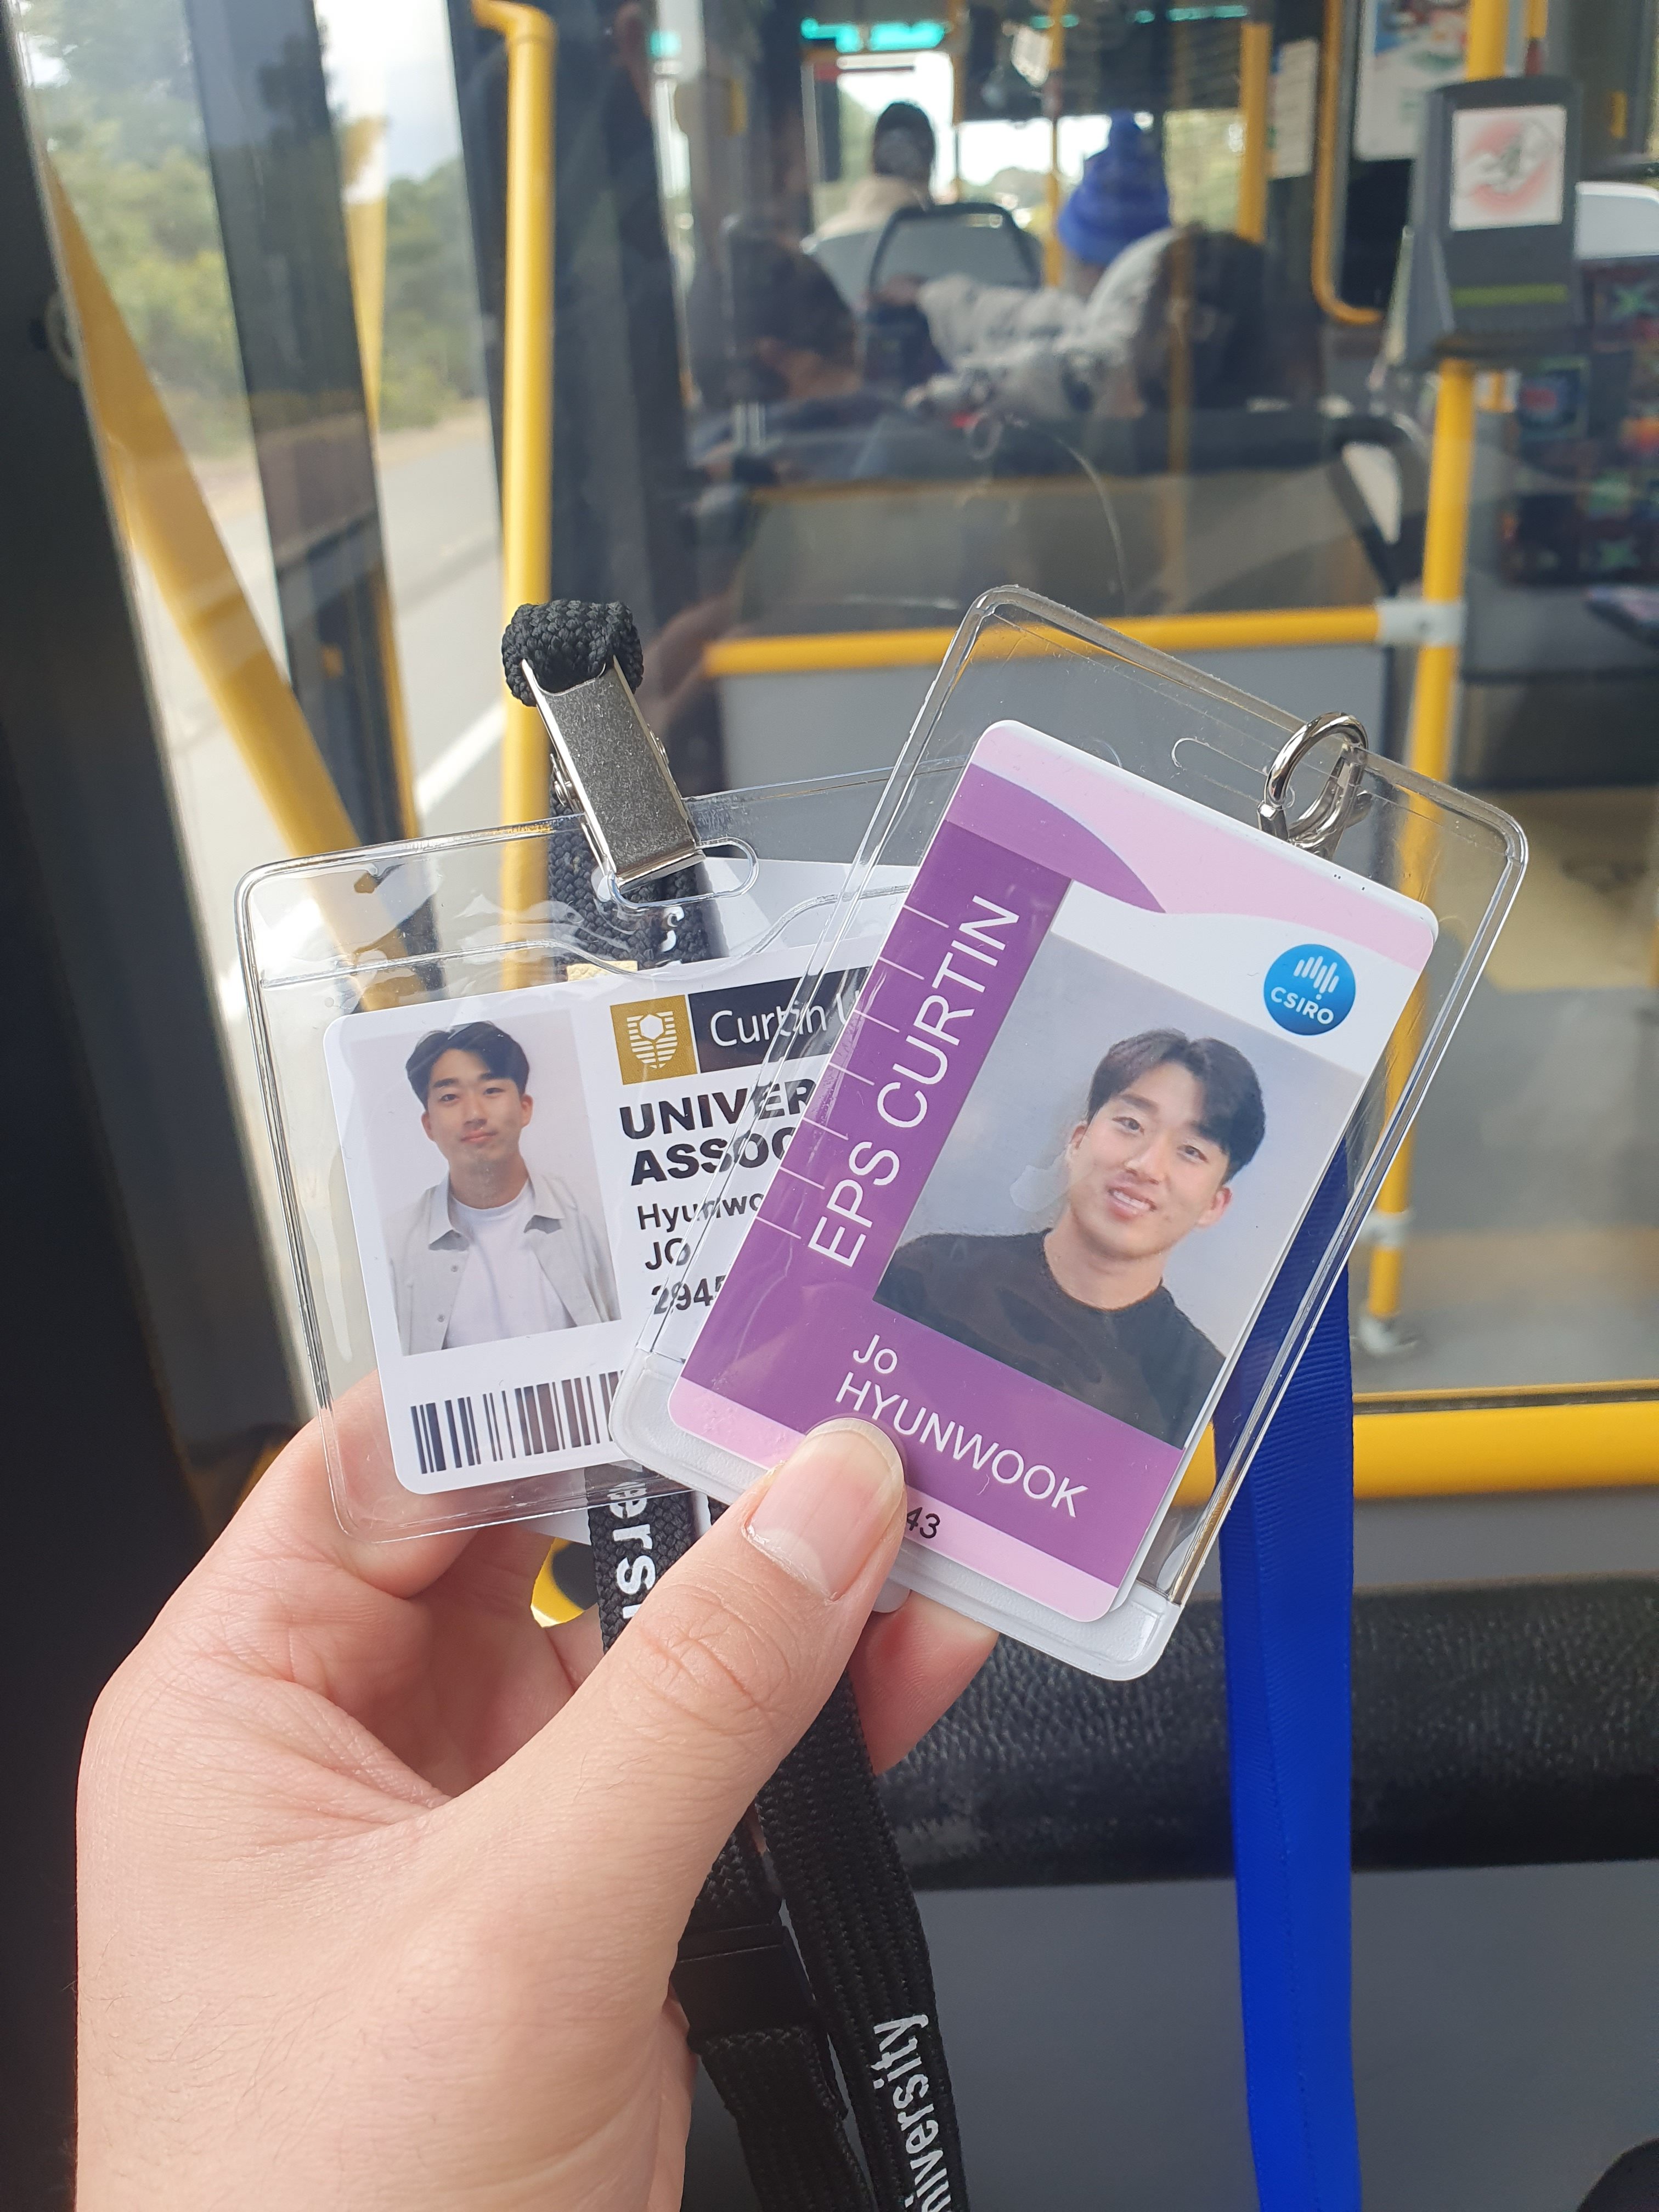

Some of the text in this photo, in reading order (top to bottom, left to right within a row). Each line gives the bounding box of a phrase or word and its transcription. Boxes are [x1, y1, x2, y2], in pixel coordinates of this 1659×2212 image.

[710, 1000, 827, 1047] Curtin
[1270, 986, 1334, 1025] CSIRO
[808, 895, 1020, 1268] EPS CURTIN
[619, 1078, 817, 1139] UNIVER
[645, 1237, 691, 1270] JO
[835, 1372, 1088, 1518] HYUNWOOK
[906, 1506, 940, 1539] 43
